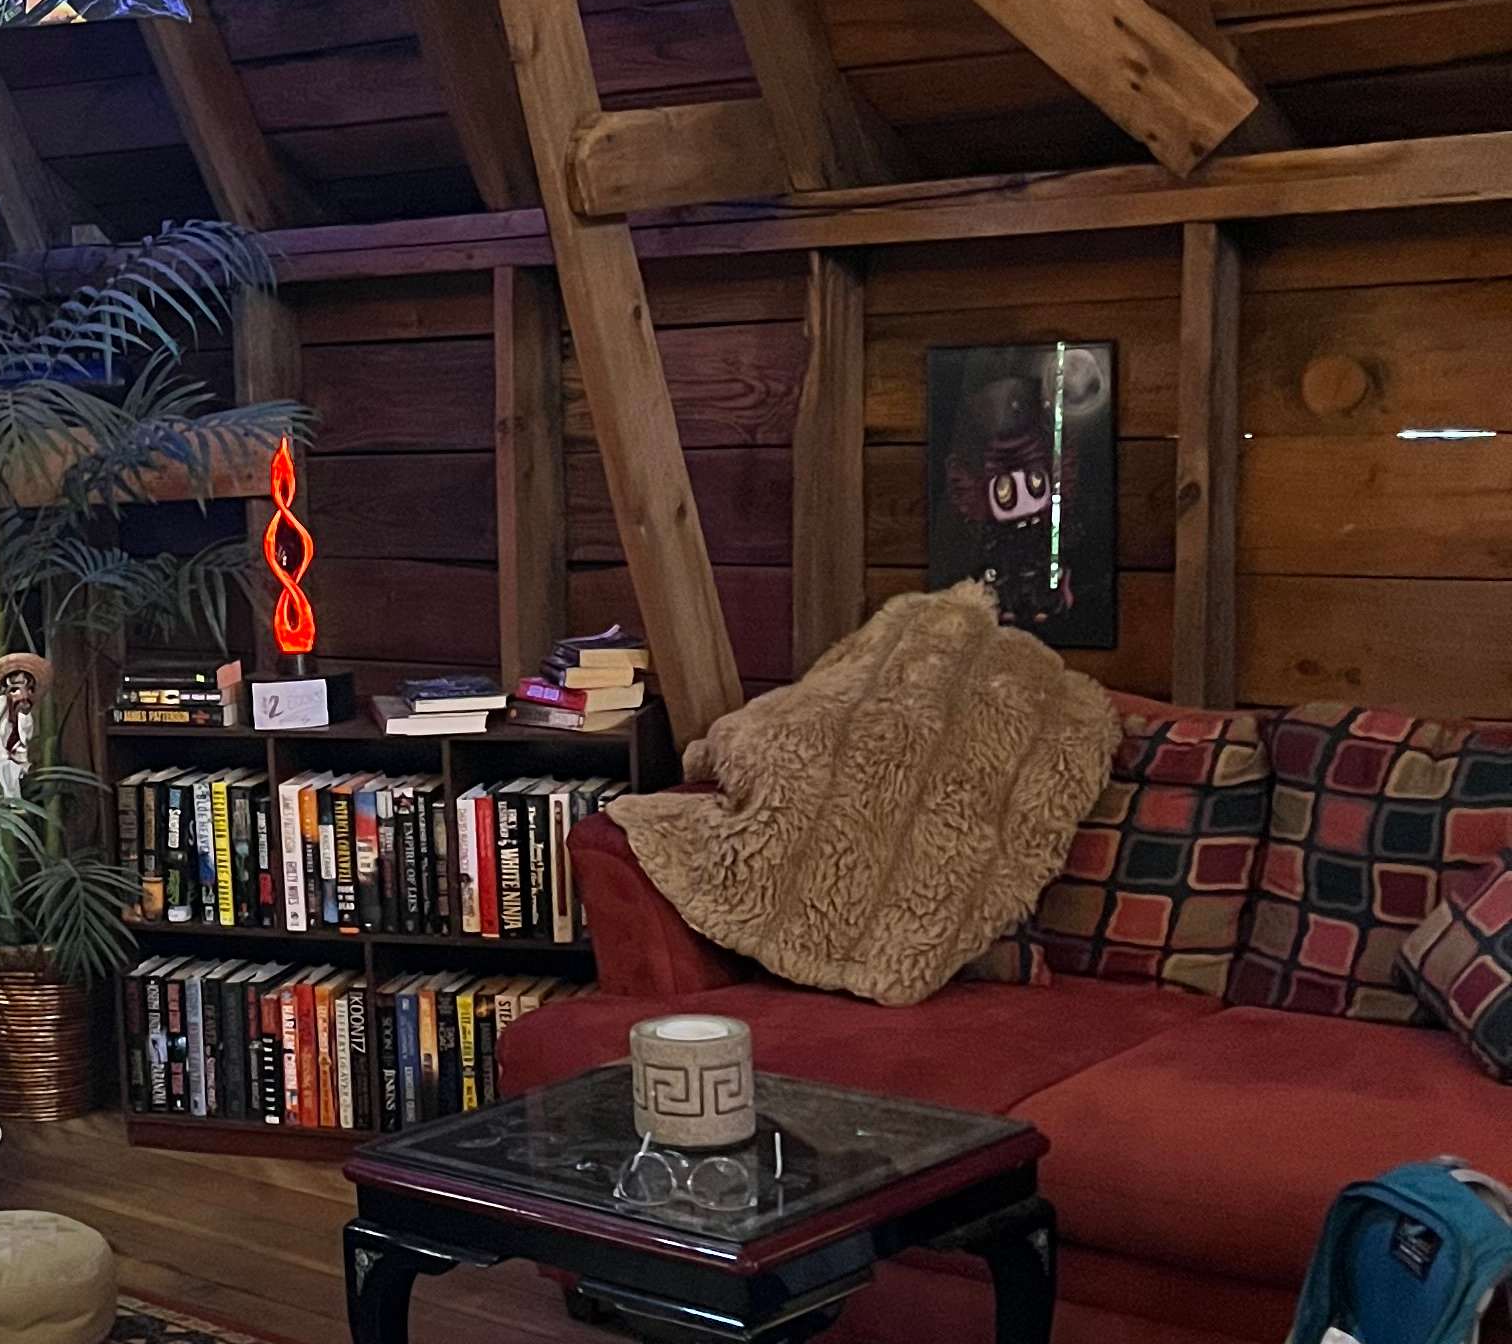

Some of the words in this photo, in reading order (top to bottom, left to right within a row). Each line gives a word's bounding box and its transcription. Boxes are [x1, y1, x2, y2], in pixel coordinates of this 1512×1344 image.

[335, 800, 350, 837] PATRICIA
[336, 839, 352, 883] CORNWELL
[403, 822, 416, 864] EMPIRE
[406, 868, 417, 884] OF
[500, 848, 520, 890] WHITE
[406, 887, 418, 913] LIES
[501, 891, 523, 930] NINJA
[349, 996, 366, 1054] KOONTZ
